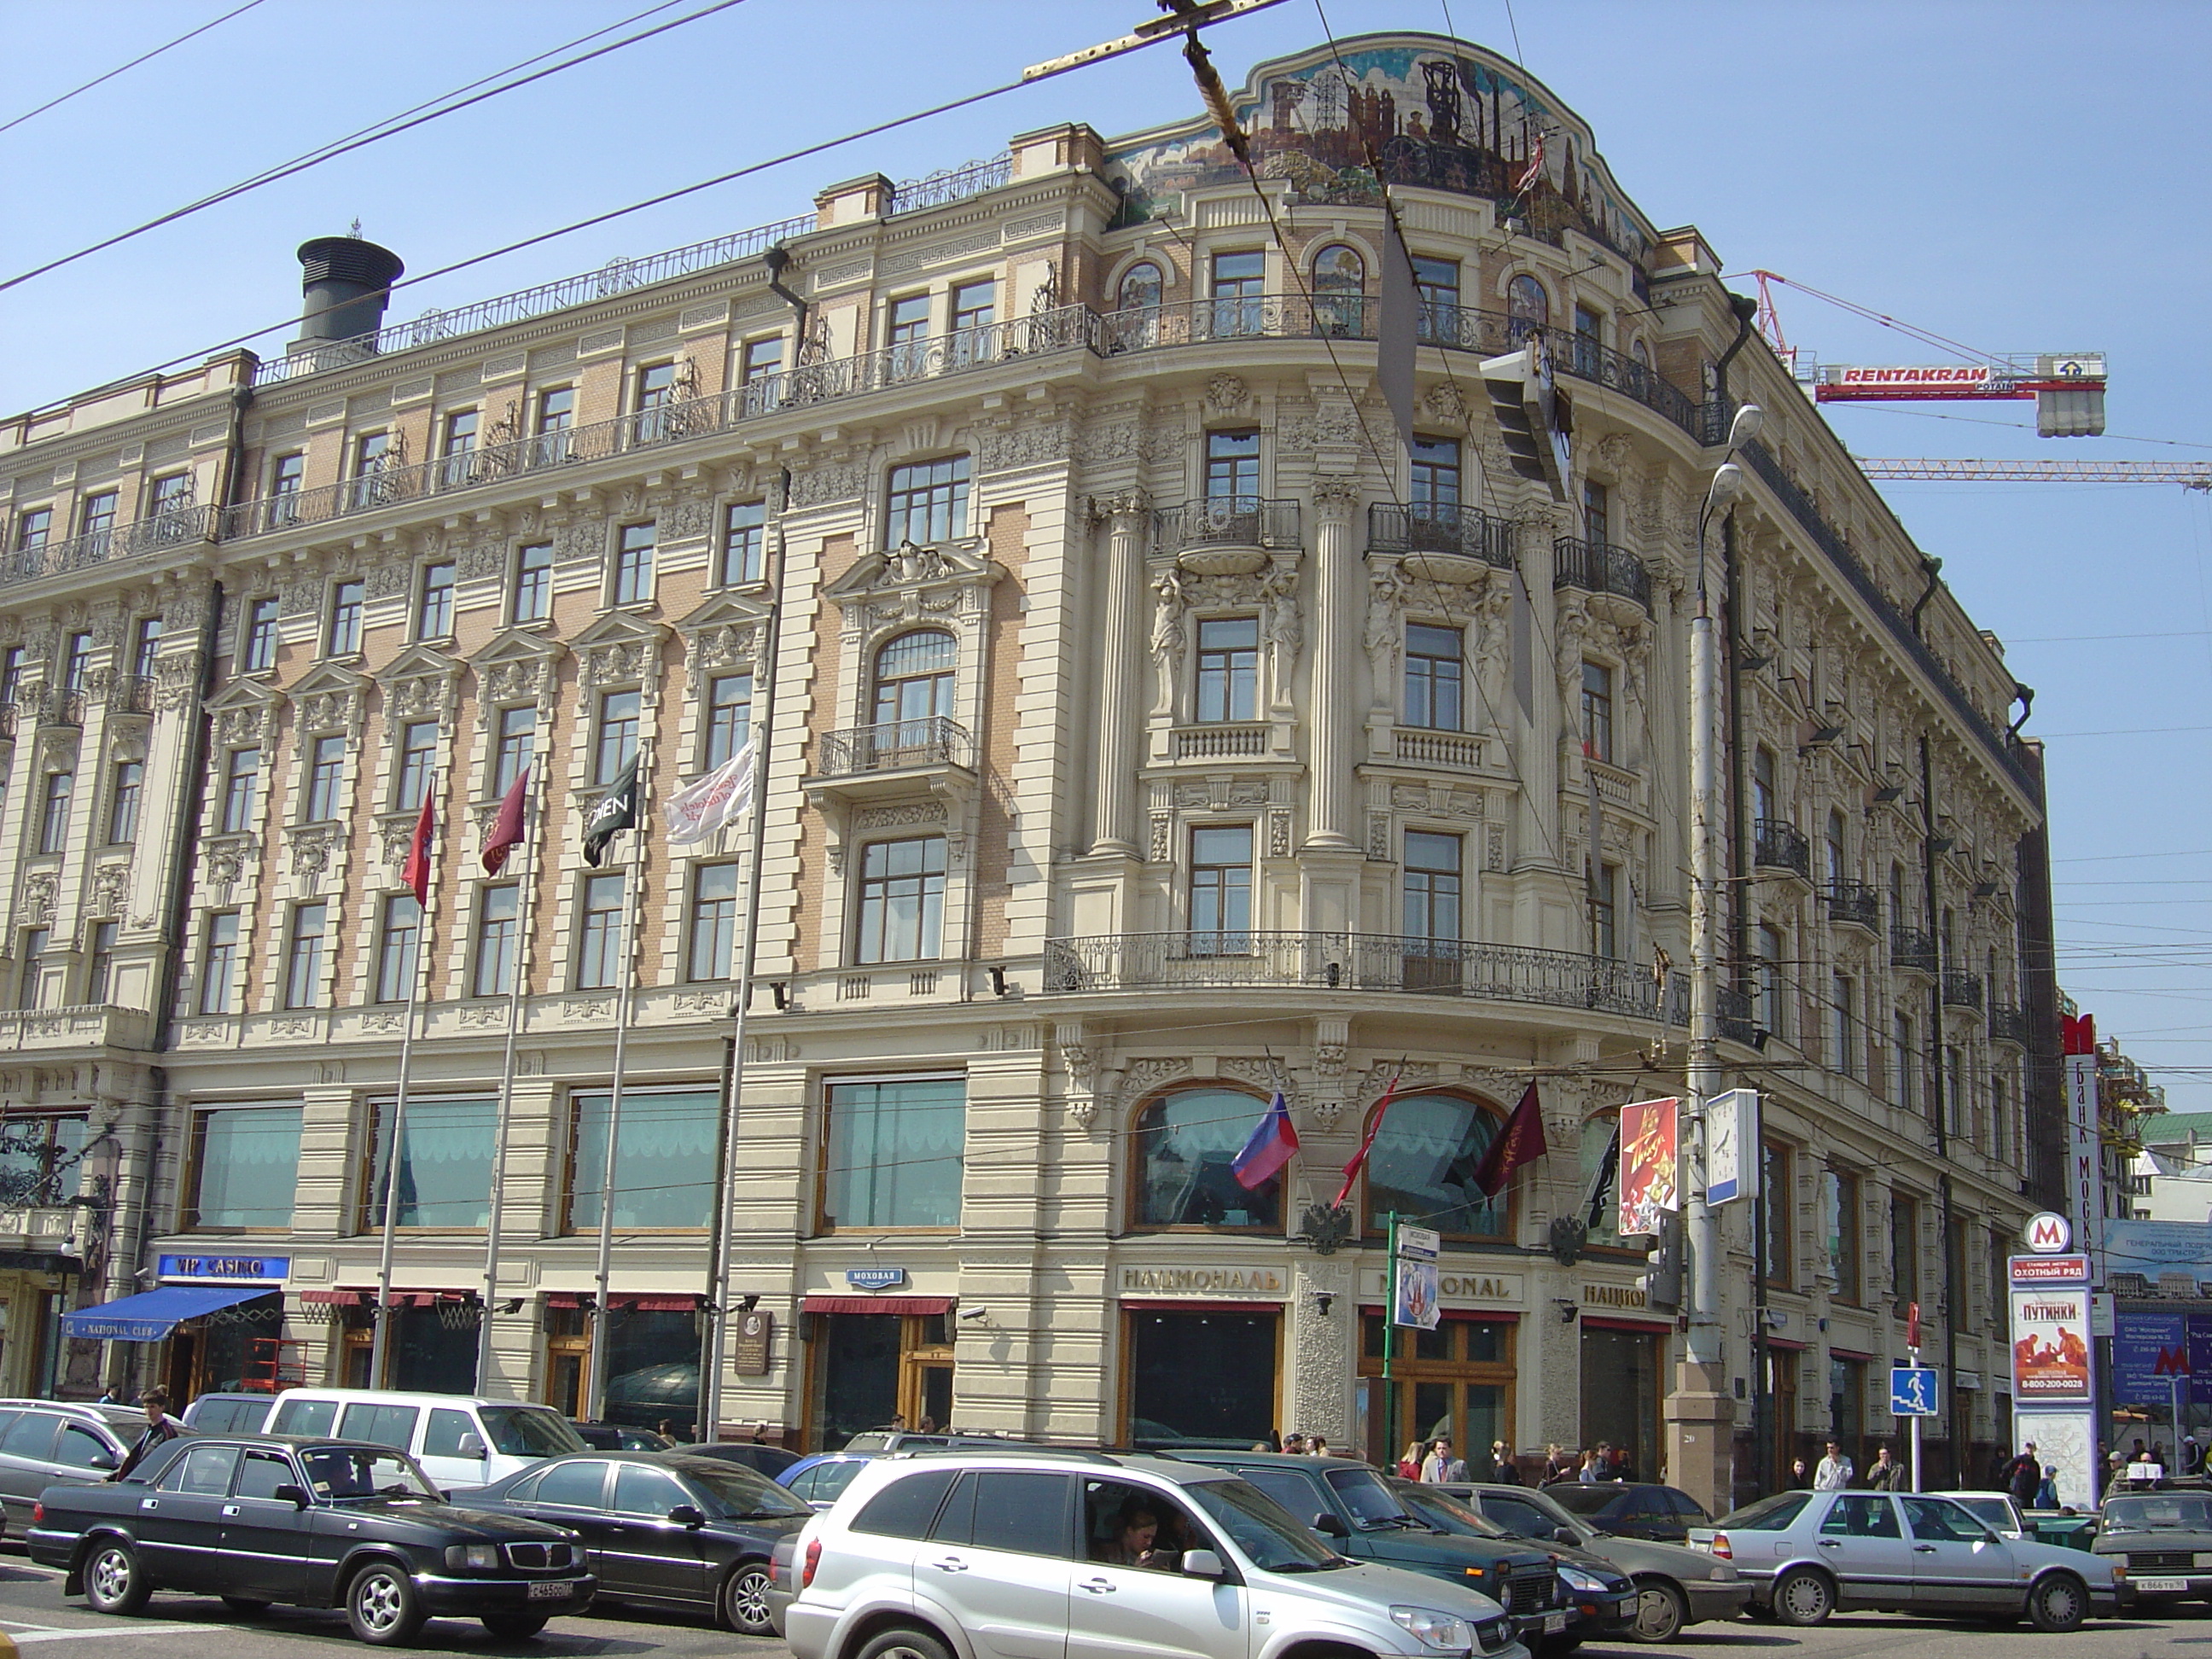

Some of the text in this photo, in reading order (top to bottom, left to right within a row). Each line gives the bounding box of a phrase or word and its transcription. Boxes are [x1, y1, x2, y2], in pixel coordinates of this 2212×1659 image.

[1845, 367, 1988, 381] RENTAKRAN
[178, 1257, 262, 1274] VIP CASINO
[2014, 1267, 2082, 1277] ОХОТНЫЙ РЯД
[853, 1272, 894, 1280] МОХОВАЯ
[1125, 1269, 1280, 1289] НАЦИОНАЛЬ
[2023, 1304, 2076, 1320] ПУТИНКИ
[87, 1324, 153, 1336] NATIONAL CLUB
